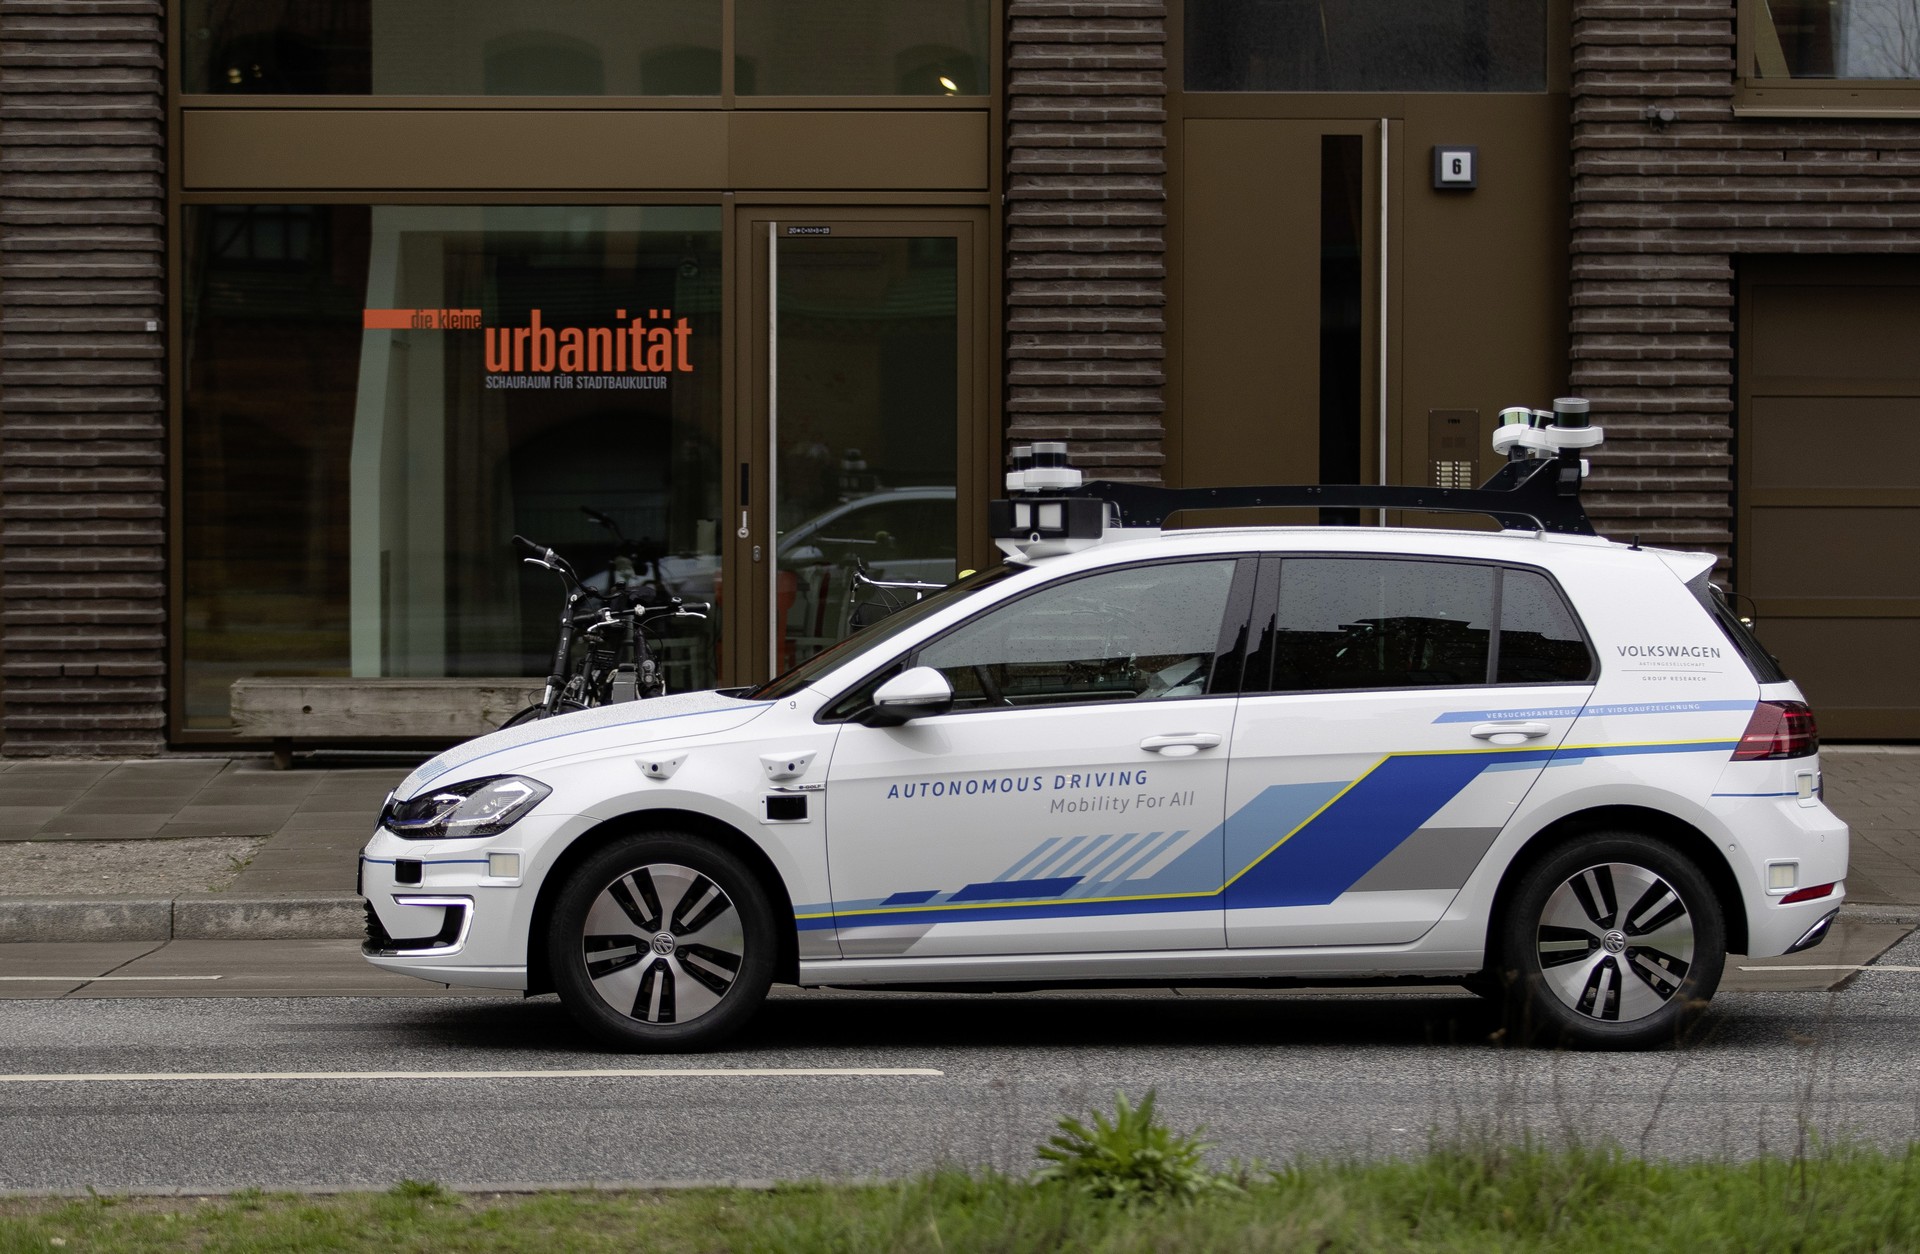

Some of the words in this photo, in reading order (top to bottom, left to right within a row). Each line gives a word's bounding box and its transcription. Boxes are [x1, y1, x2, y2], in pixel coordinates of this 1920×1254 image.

[1452, 158, 1462, 175] 6
[411, 309, 433, 329] die
[438, 309, 482, 329] kleine
[485, 309, 694, 372] urbanität
[485, 376, 550, 389] SCHAURAUM
[554, 373, 573, 389] FÜR
[576, 376, 667, 389] STADTBAUKULTUR
[1617, 645, 1721, 659] VOLKSWAGEN
[789, 700, 797, 710] 9
[1486, 708, 1577, 719] VERSUCHSFAHRZEUG
[1607, 703, 1700, 714] VIDEOAUFZEICHNUNG
[887, 776, 1043, 800] AUTONOMOUS
[1054, 770, 1147, 790] DRIVING
[1050, 796, 1130, 814] Mobility
[1136, 794, 1166, 809] For
[1170, 791, 1195, 807] All
